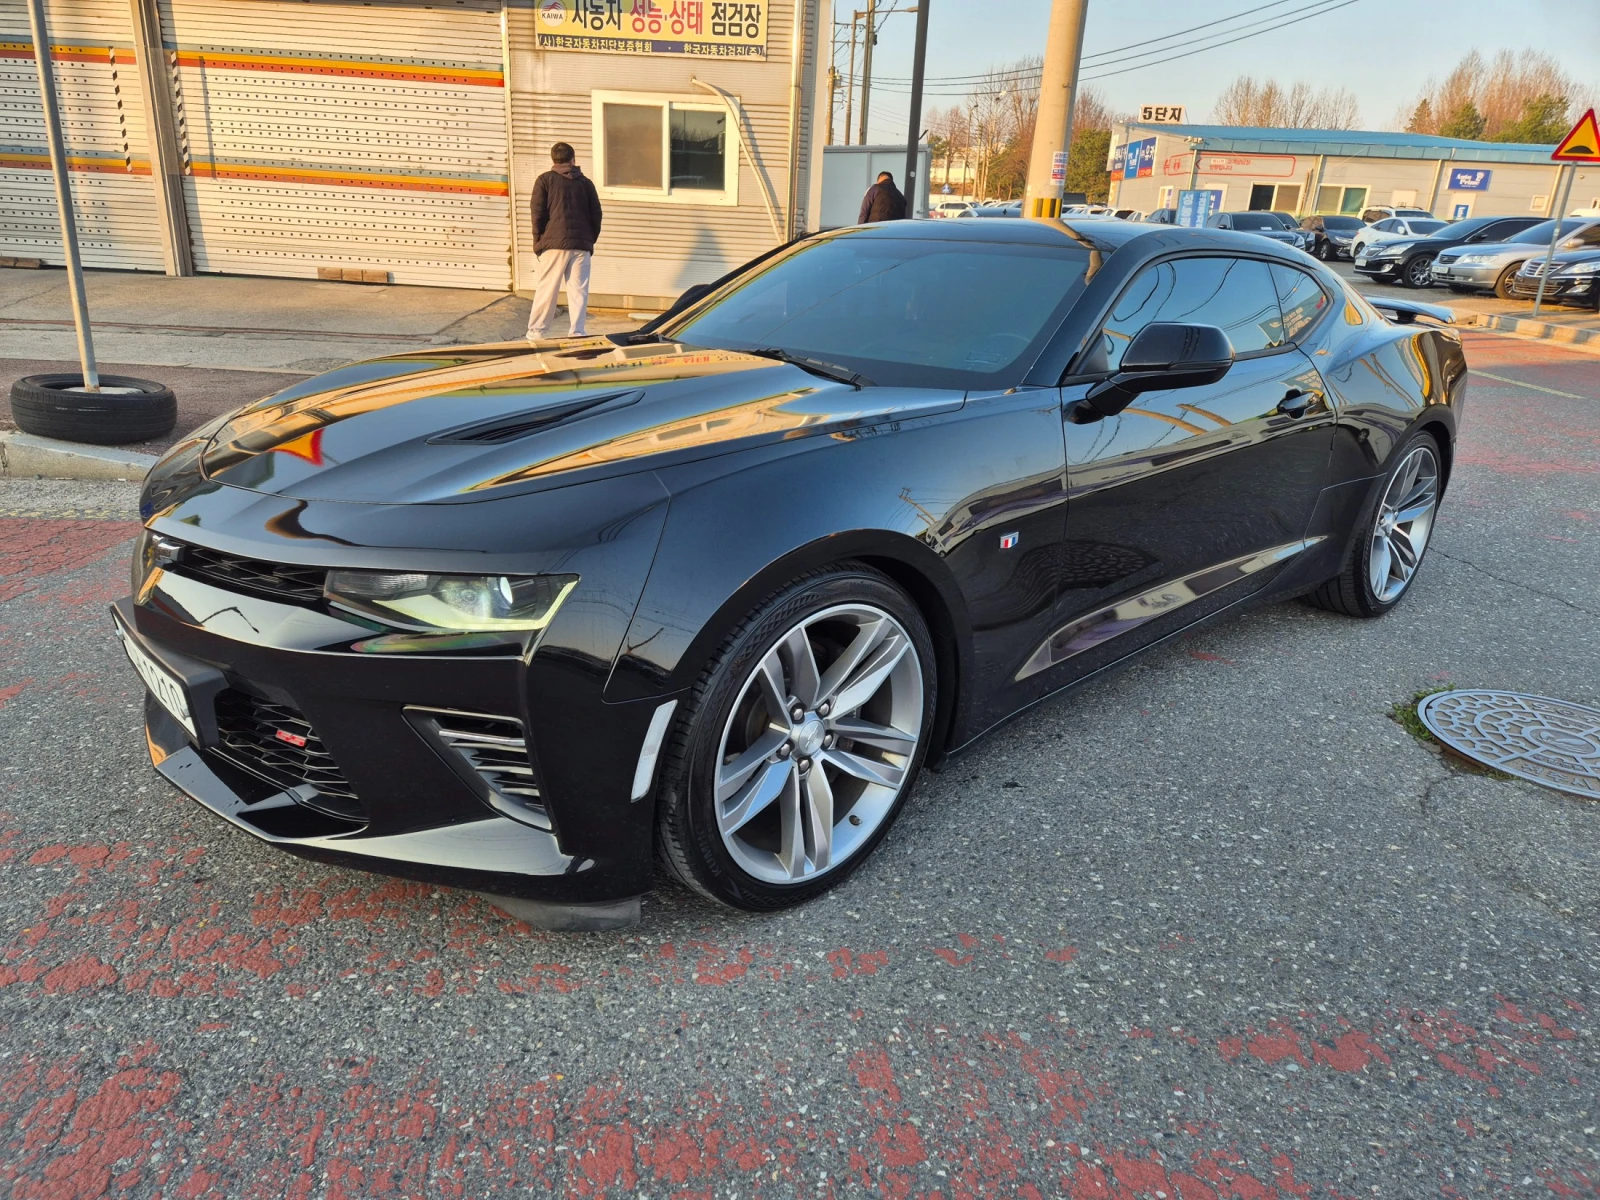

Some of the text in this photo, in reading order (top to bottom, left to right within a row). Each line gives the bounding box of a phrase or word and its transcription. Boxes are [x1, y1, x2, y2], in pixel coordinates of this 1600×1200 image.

[541, 12, 564, 20] KAIWA
[711, 2, 761, 39] 점검장
[1142, 106, 1182, 122] 5단지
